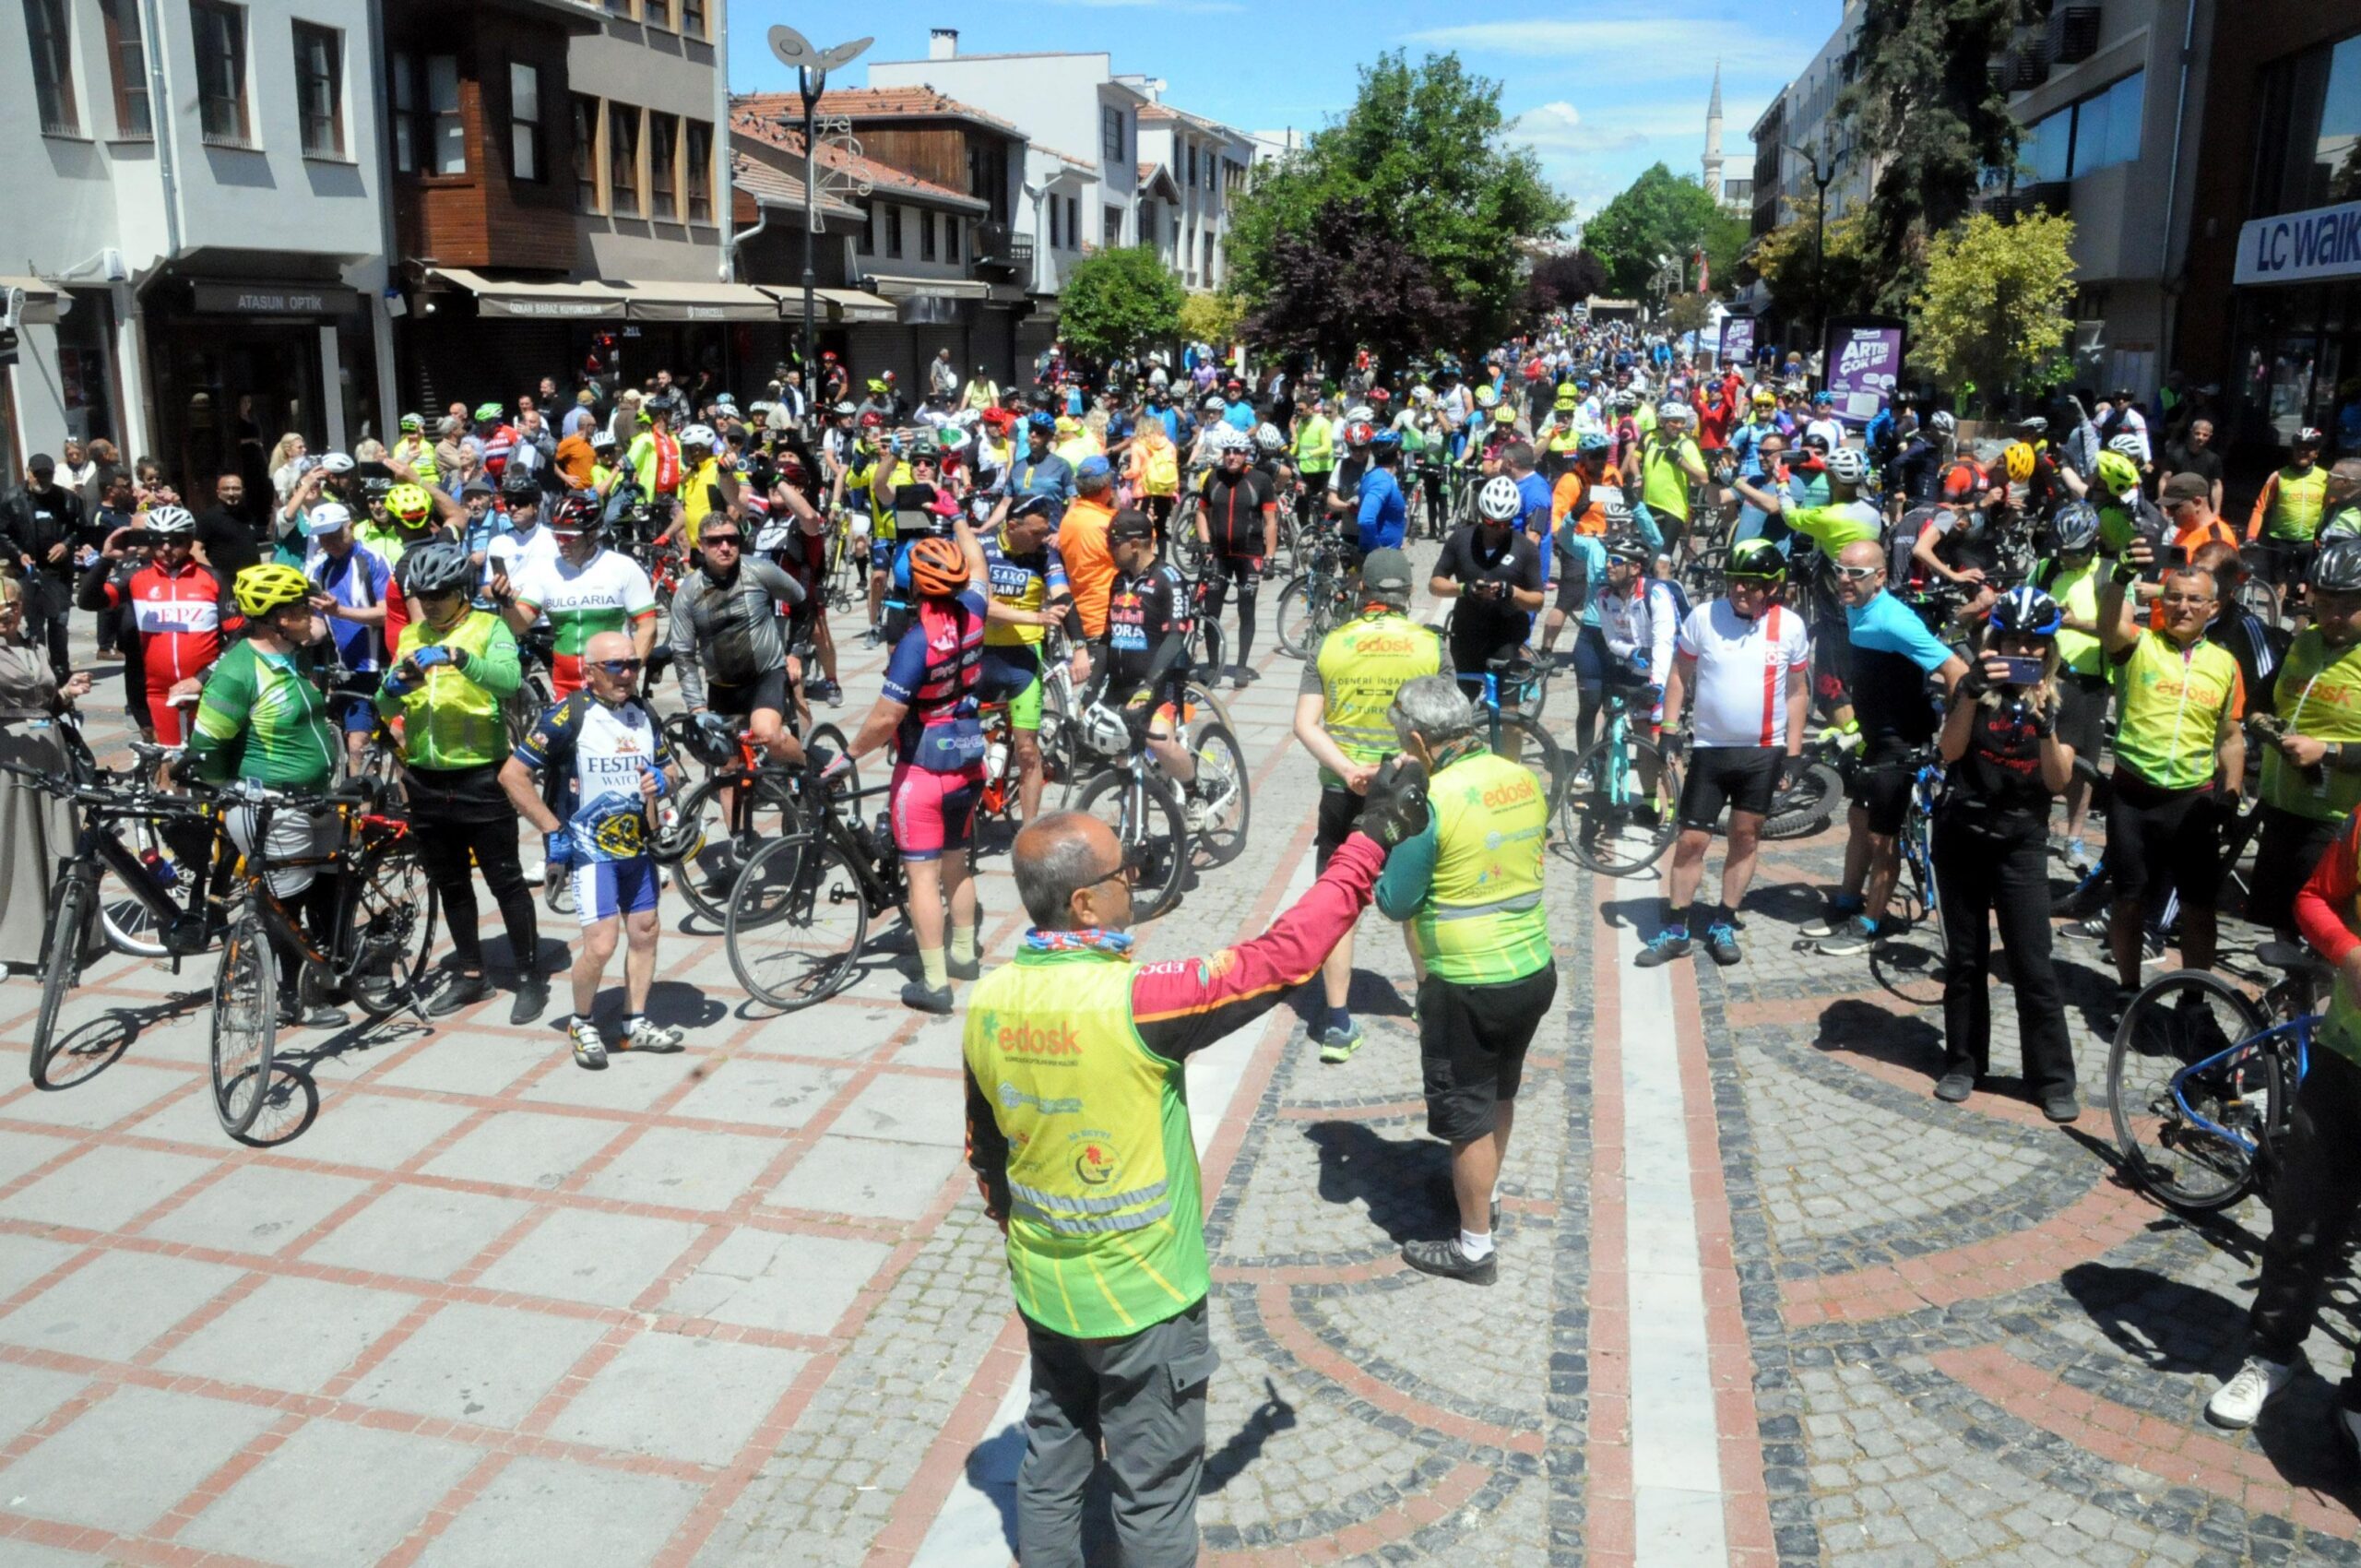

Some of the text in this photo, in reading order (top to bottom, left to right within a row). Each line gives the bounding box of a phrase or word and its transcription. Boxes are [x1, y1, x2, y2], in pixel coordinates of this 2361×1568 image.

[2256, 222, 2290, 272] LC
[238, 294, 284, 310] ATASUN
[991, 568, 1026, 585] SAXO
[1171, 588, 1184, 620] BOSS
[1356, 636, 1415, 654] edosk
[1483, 777, 1535, 808] edosk
[998, 1019, 1083, 1056] edosk
